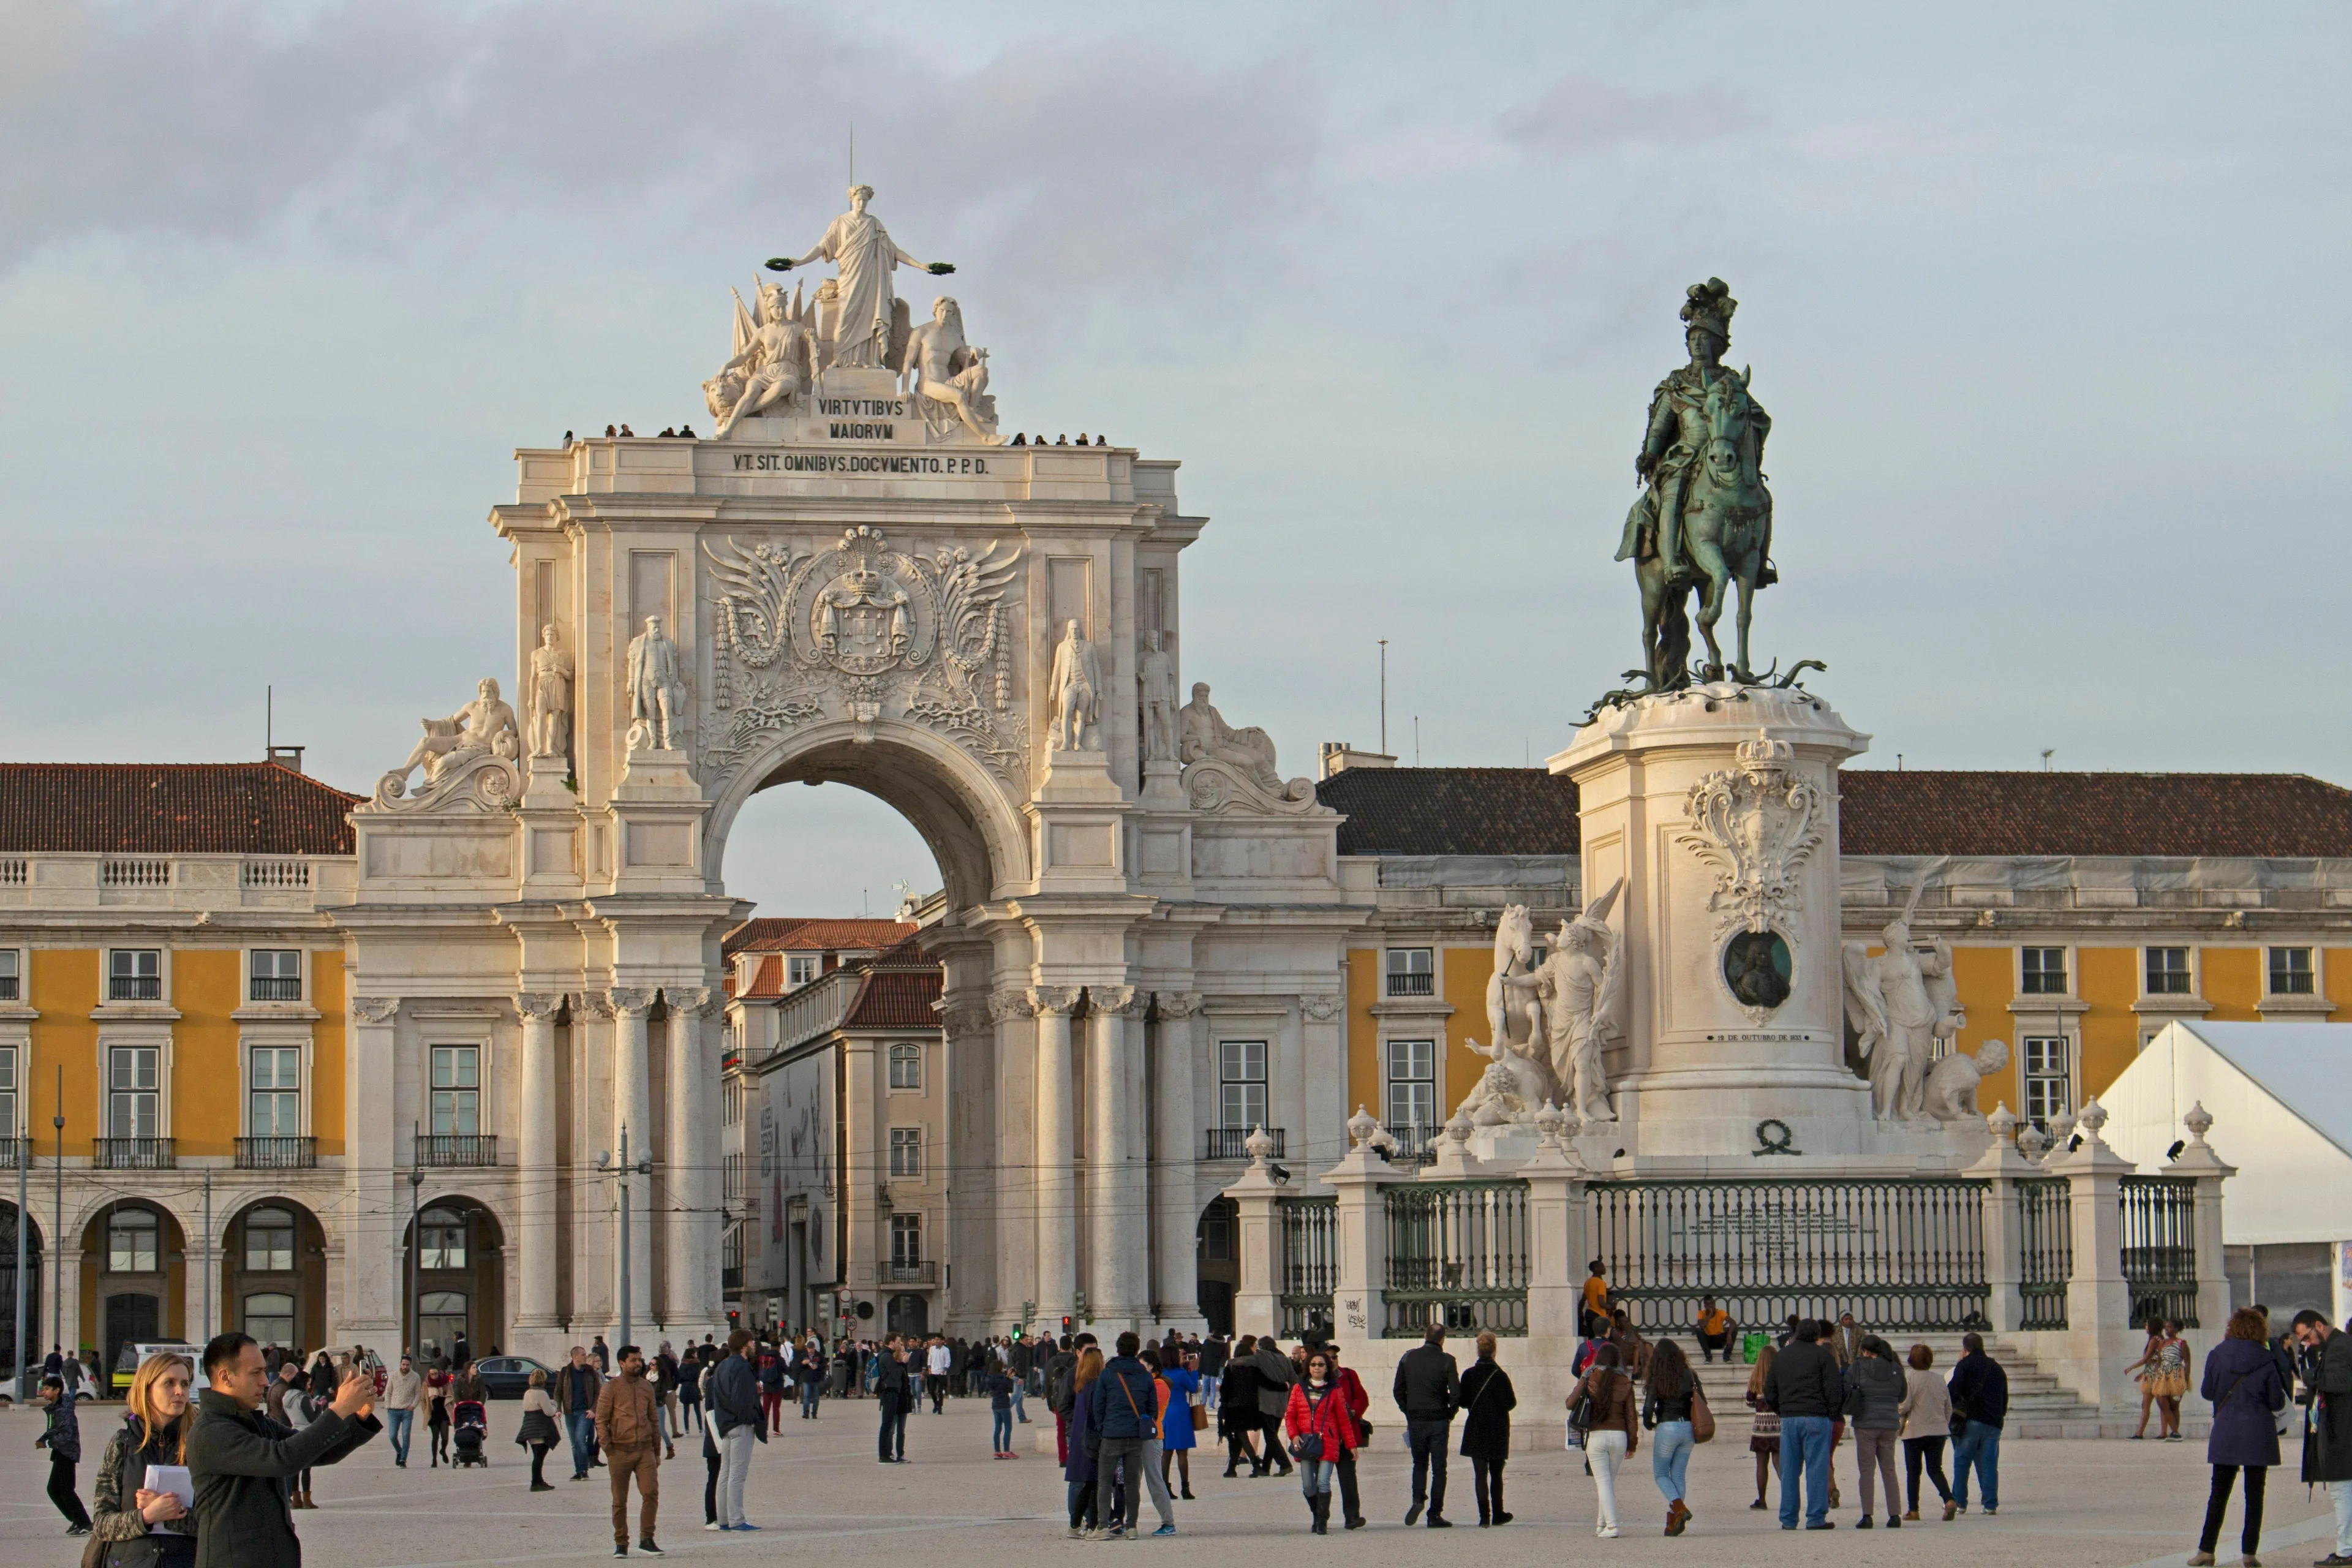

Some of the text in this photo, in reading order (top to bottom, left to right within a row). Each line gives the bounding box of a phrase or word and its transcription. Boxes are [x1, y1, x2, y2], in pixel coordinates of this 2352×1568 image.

[818, 399, 903, 416] VIRTVTIBVS
[830, 423, 893, 439] MAIORVM
[733, 454, 753, 470] VT.
[757, 455, 780, 470] SIT.
